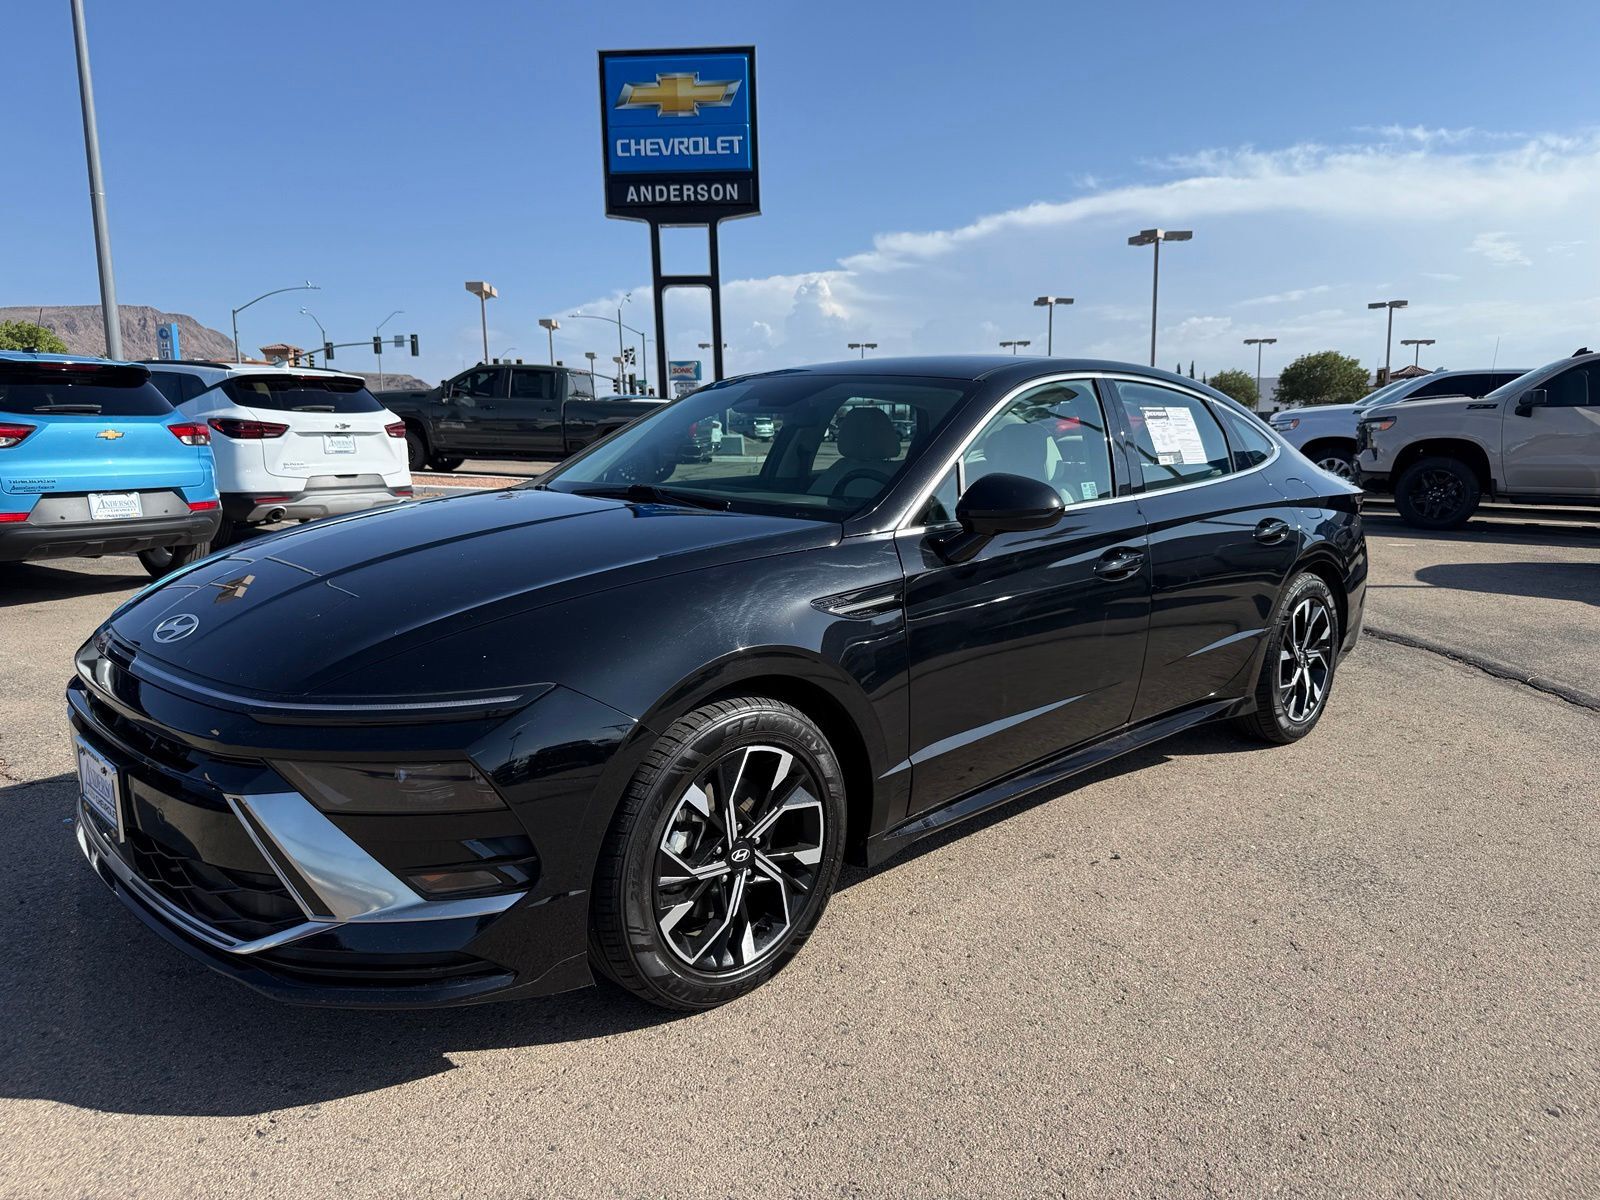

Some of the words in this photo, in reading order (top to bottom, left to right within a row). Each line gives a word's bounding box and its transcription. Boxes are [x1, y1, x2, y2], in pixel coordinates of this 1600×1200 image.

[616, 136, 743, 157] CHEVROLET
[626, 184, 739, 203] ANDERSON
[672, 367, 693, 375] SONIC
[96, 499, 137, 513] ANDERSON
